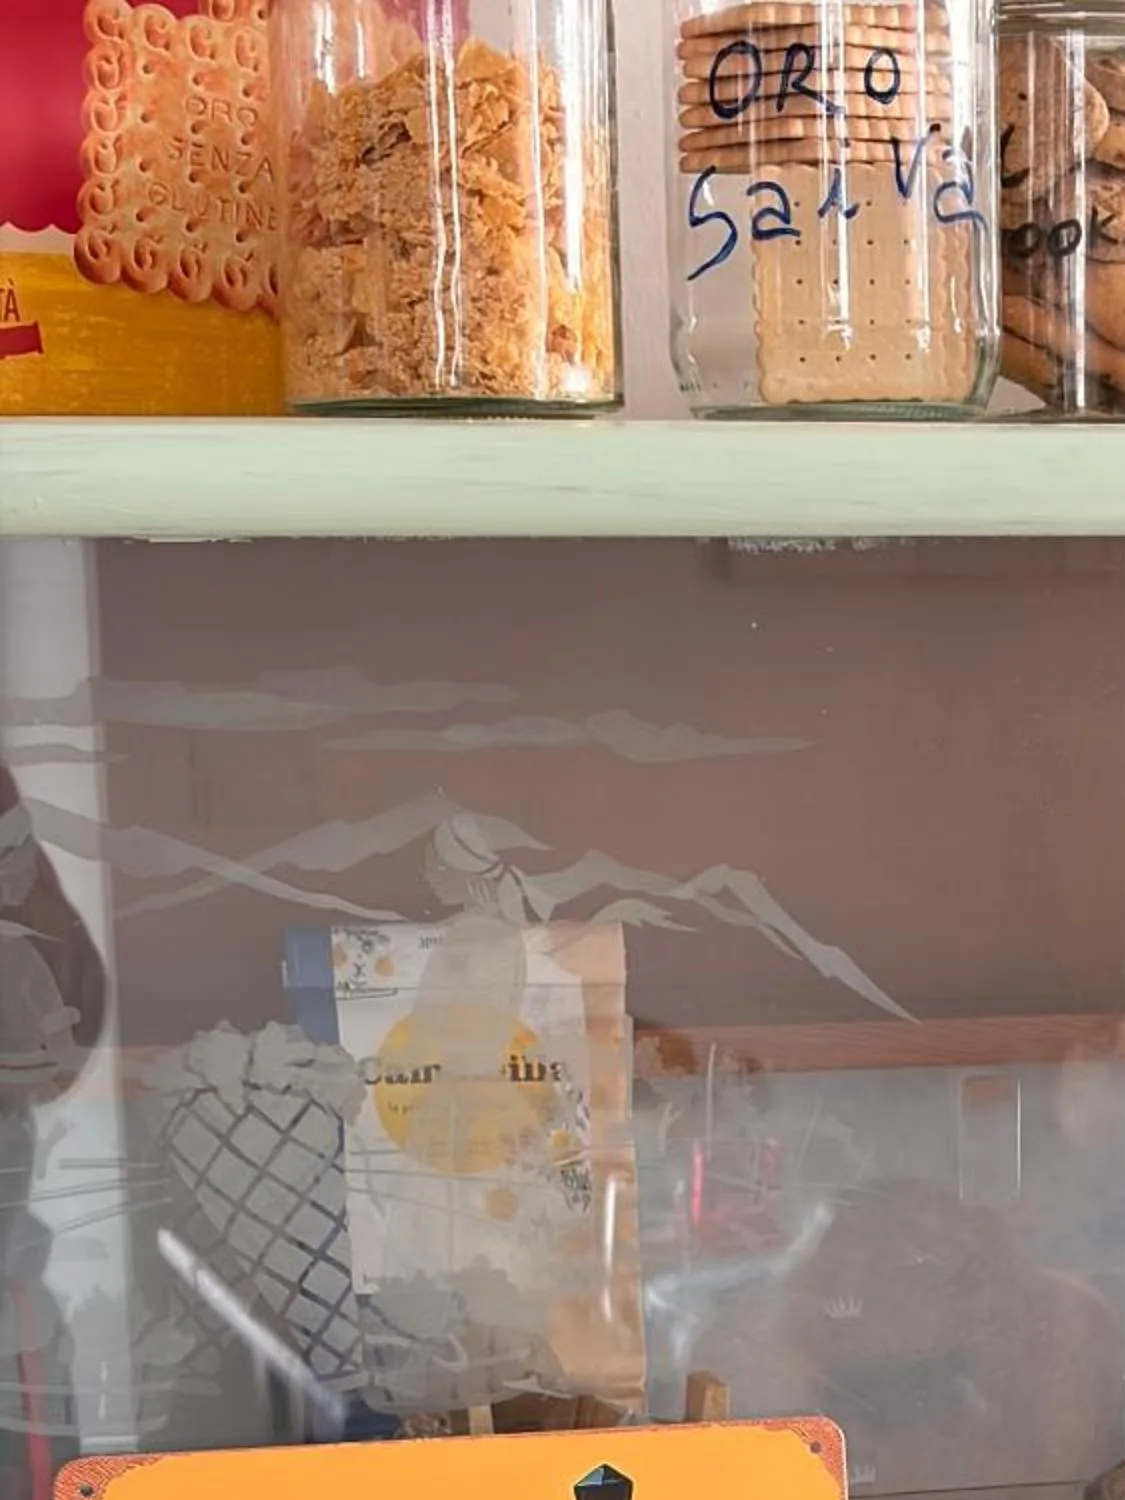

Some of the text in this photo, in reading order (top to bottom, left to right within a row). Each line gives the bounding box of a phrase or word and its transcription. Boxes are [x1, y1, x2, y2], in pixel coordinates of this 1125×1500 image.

[709, 41, 901, 119] ORO
[185, 96, 258, 128] ORO
[165, 136, 275, 183] SENZA
[149, 182, 276, 231] GLUTINE
